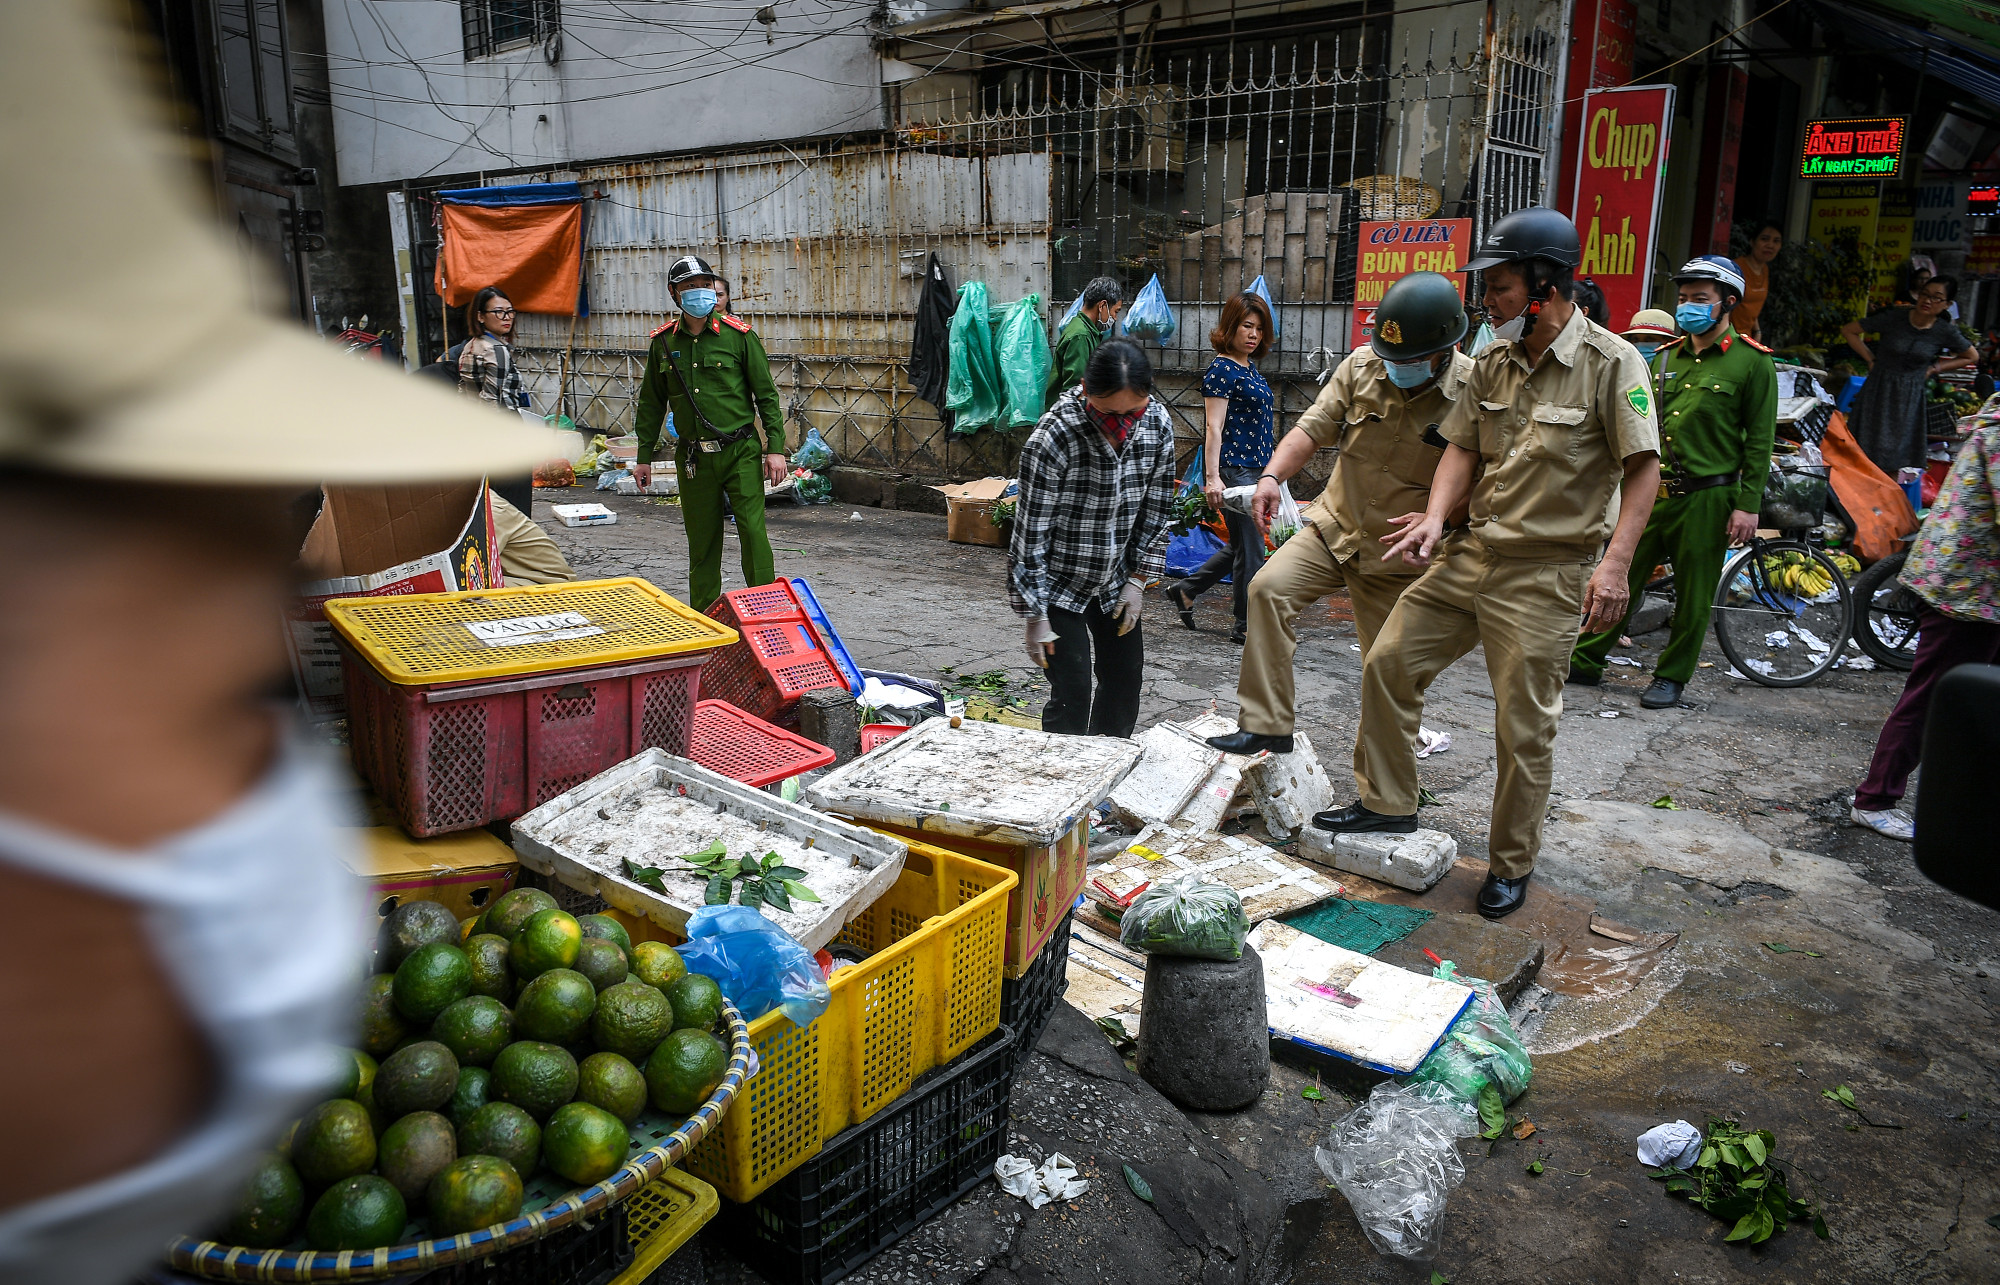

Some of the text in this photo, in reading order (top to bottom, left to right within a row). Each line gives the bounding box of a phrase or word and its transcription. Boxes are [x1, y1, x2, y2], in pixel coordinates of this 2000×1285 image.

[1588, 107, 1656, 182] Chụp
[1806, 124, 1854, 154] ẢNH
[1856, 121, 1900, 153] THẺ
[1803, 156, 1824, 173] LẤY
[1825, 160, 1855, 173] NGAY
[1846, 205, 1870, 217] KHÔ
[1370, 221, 1455, 244] CÔ LIÊN
[1579, 195, 1636, 275] Ảnh
[1913, 212, 1961, 241] HUỐC
[1362, 243, 1457, 273] BÚN CHẢ
[1357, 276, 1384, 301] BÚN
